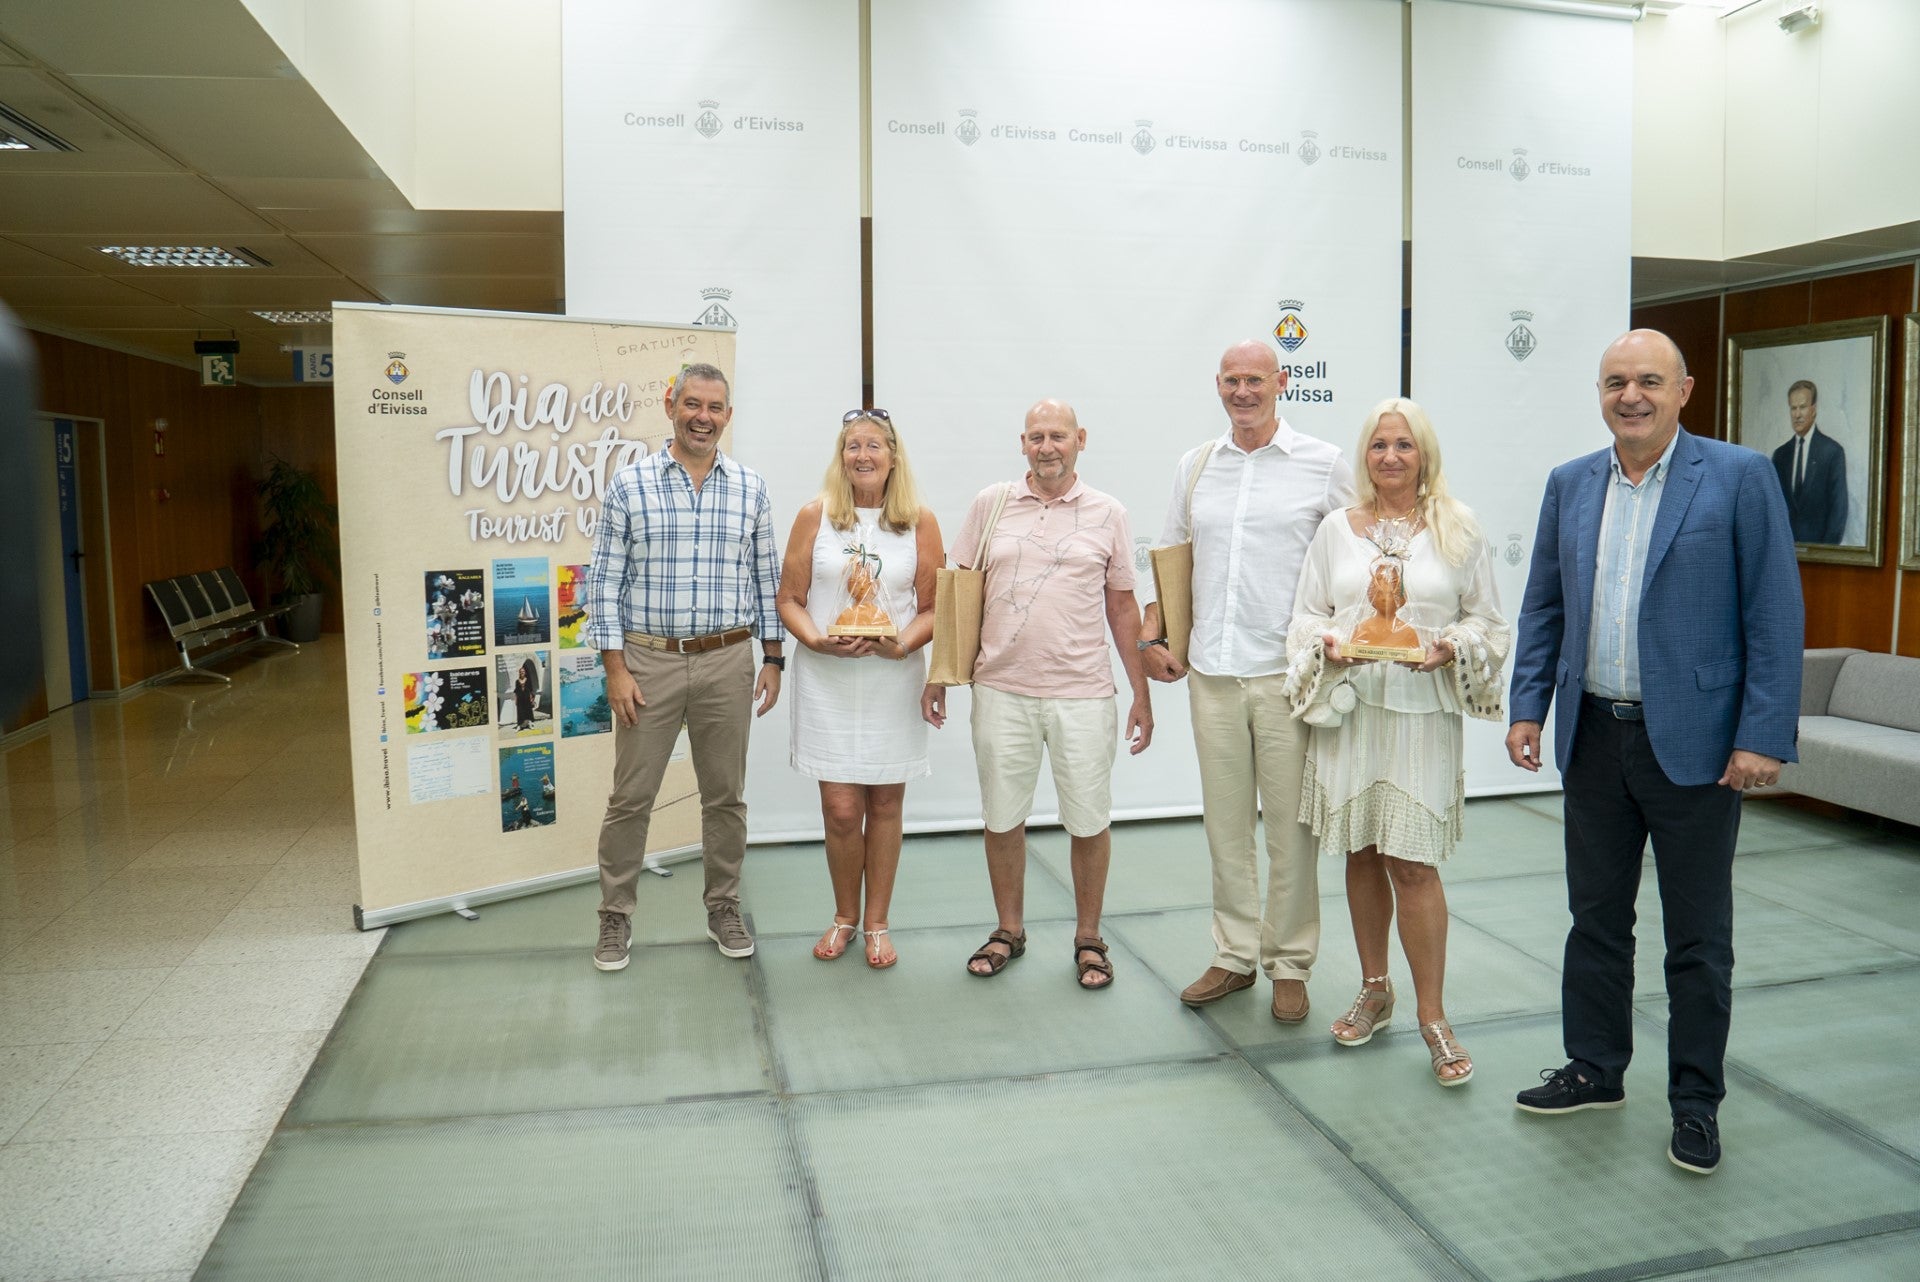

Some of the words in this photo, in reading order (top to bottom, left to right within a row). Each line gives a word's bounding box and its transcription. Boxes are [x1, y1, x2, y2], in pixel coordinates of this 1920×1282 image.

[623, 112, 685, 127] Consell
[733, 116, 804, 132] d'Eivissa
[887, 119, 945, 135] Consell
[990, 125, 1056, 141] d'Eivissa
[1068, 128, 1122, 144] Consell
[1165, 135, 1228, 151] d'Eivissa
[1238, 139, 1290, 155] Consell
[1329, 145, 1387, 162] d'Eivissa
[1457, 156, 1502, 171] Consell
[1537, 162, 1591, 177] d'Eivissa
[617, 334, 697, 356] GRATUITO
[319, 353, 334, 378] 5
[1281, 361, 1326, 379] nsell
[372, 388, 423, 401] Consell
[638, 380, 669, 393] VEN
[1278, 384, 1333, 402] vissa
[368, 403, 428, 415] d'Eivissa
[469, 369, 578, 435] Dia
[580, 381, 634, 423] del
[463, 506, 572, 543] Tourist
